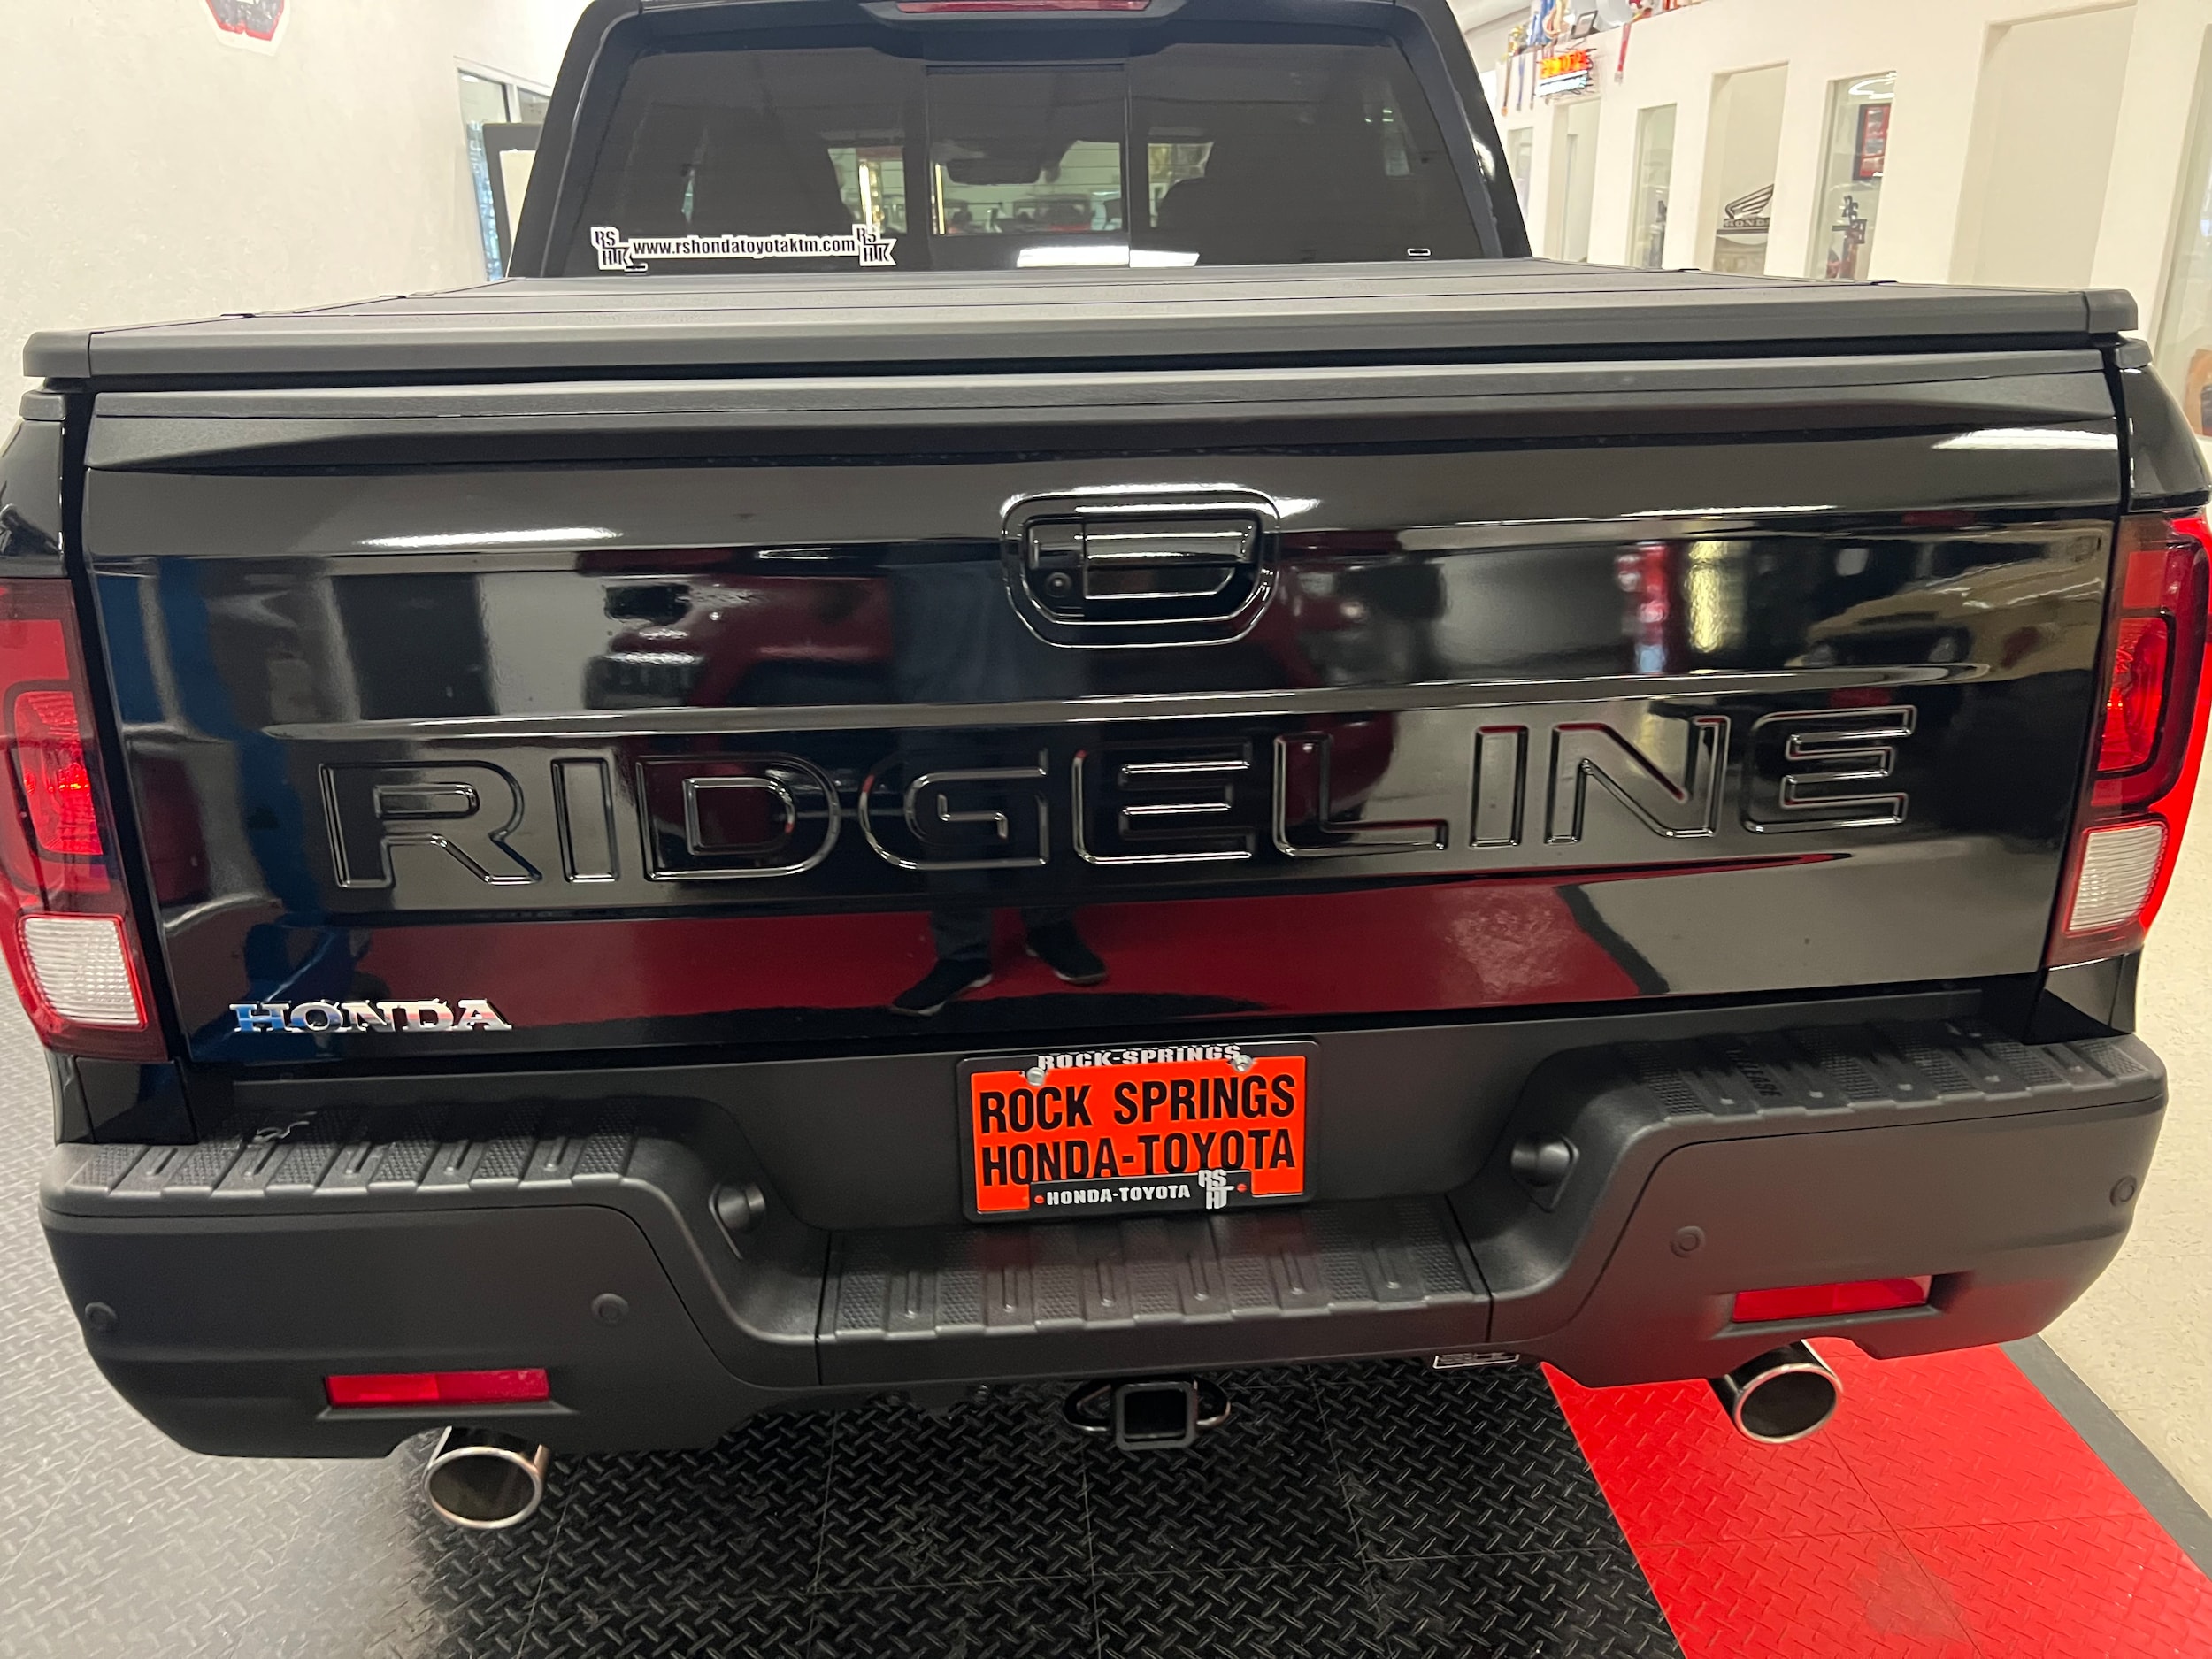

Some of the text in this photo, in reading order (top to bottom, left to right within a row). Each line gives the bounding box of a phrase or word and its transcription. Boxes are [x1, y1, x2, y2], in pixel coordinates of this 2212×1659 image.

[595, 230, 617, 248] RS
[634, 238, 856, 255] www.rshondatoyotaktm.com
[317, 704, 1918, 889] RIDGELINE
[229, 998, 513, 1033] HONDA
[1038, 1043, 1241, 1071] ROCK-SPRINGS
[979, 1074, 1295, 1134] ROCK SPRINGS
[982, 1128, 1295, 1186] HONDA-TOYOTA
[1198, 1169, 1227, 1187] RS
[1046, 1184, 1191, 1206] HONDA-TOYOTA
